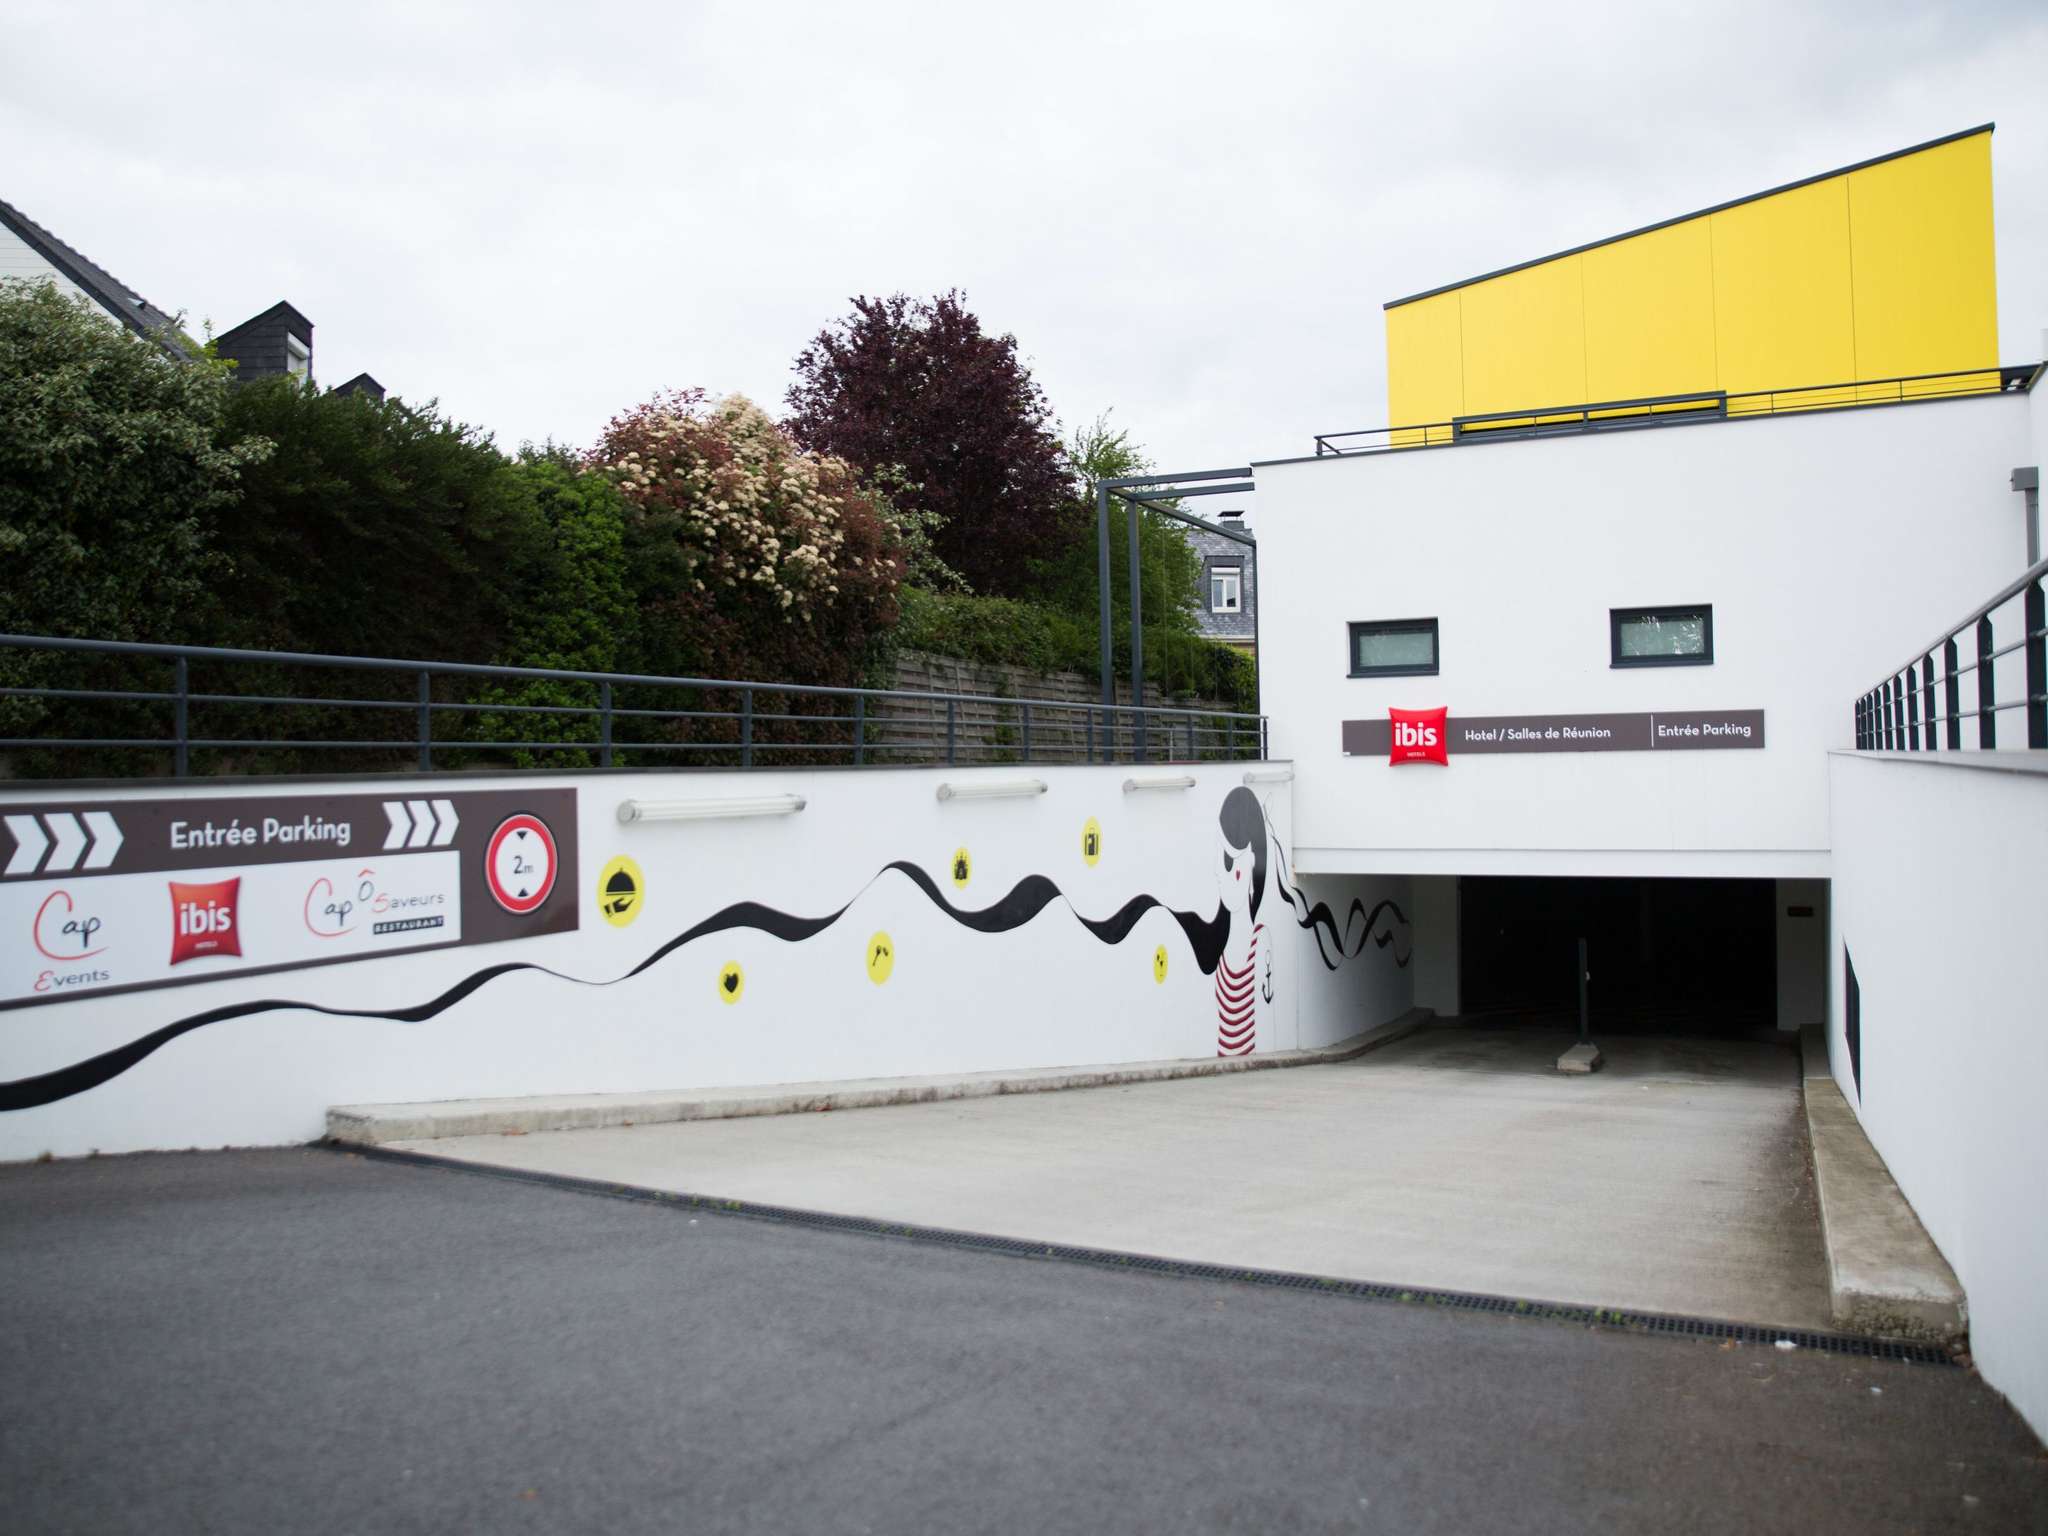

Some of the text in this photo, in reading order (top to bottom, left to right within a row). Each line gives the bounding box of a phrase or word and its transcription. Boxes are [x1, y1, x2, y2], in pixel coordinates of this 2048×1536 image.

[1395, 722, 1437, 747] ibis
[1465, 727, 1611, 741] Hotel / Salles de Réunion
[1658, 723, 1751, 738] Entrée Parking
[170, 815, 351, 849] Entrée Parking
[180, 900, 232, 935] ibis
[304, 877, 358, 937] Cap
[371, 893, 446, 913] Saveurs
[33, 890, 110, 961] Cap
[374, 917, 443, 933] RESTAURANT
[34, 970, 110, 992] Events
